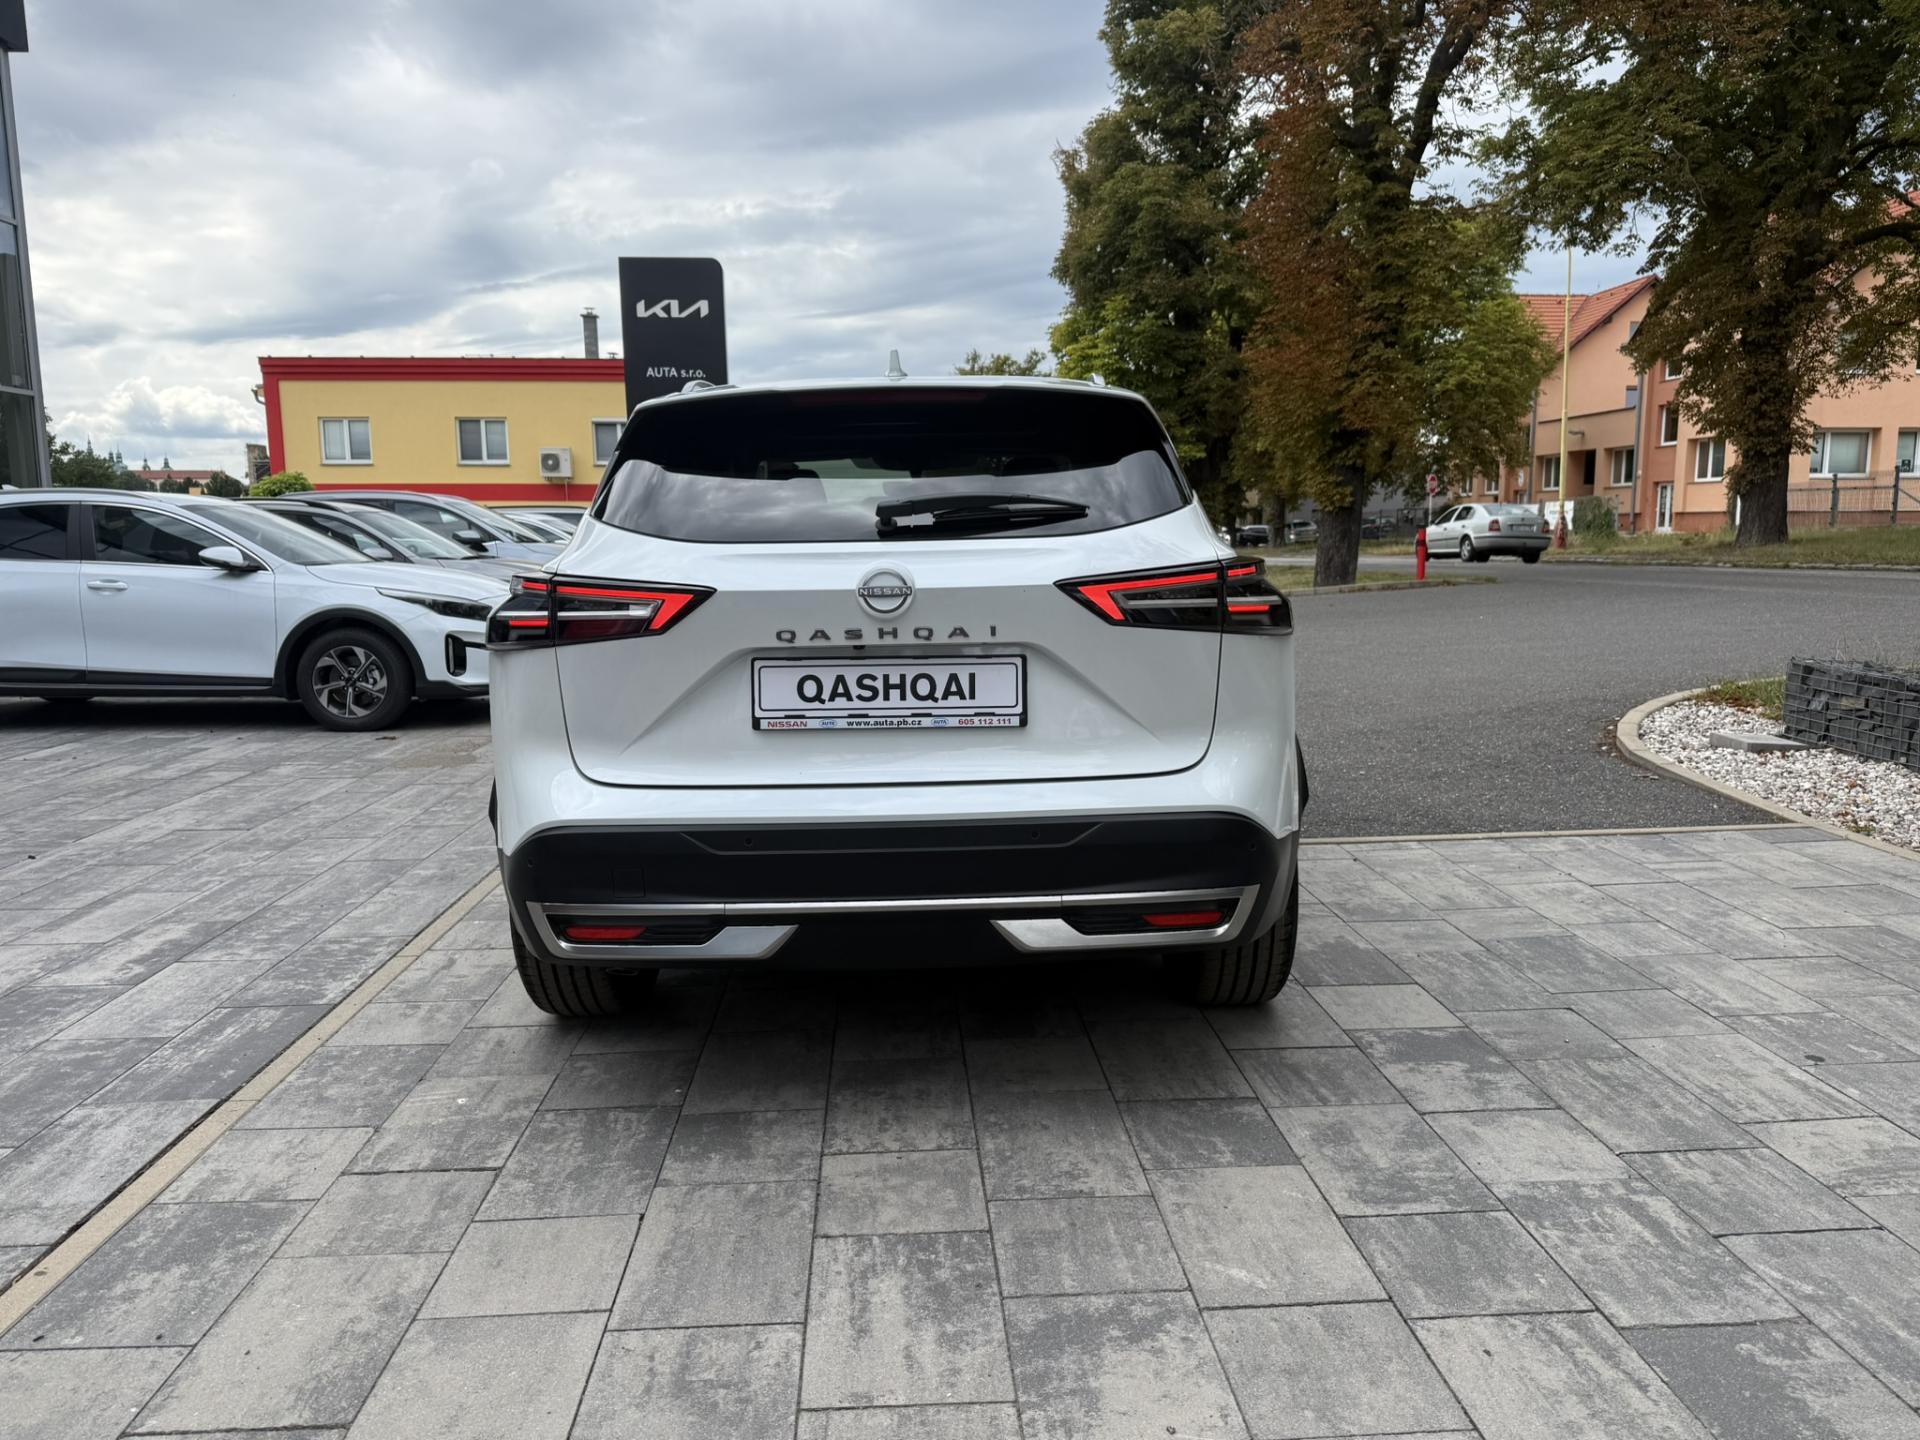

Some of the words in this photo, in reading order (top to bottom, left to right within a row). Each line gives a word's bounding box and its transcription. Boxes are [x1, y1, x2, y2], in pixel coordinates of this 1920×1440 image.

[635, 299, 709, 318] KIA
[646, 367, 678, 378] AUTA
[681, 369, 706, 378] s.r.o.
[859, 587, 911, 595] NISSAN
[776, 624, 997, 643] QASHQAI
[797, 672, 976, 704] QASHQAI
[846, 718, 922, 727] www.auta.pb.cz
[978, 718, 993, 726] 112
